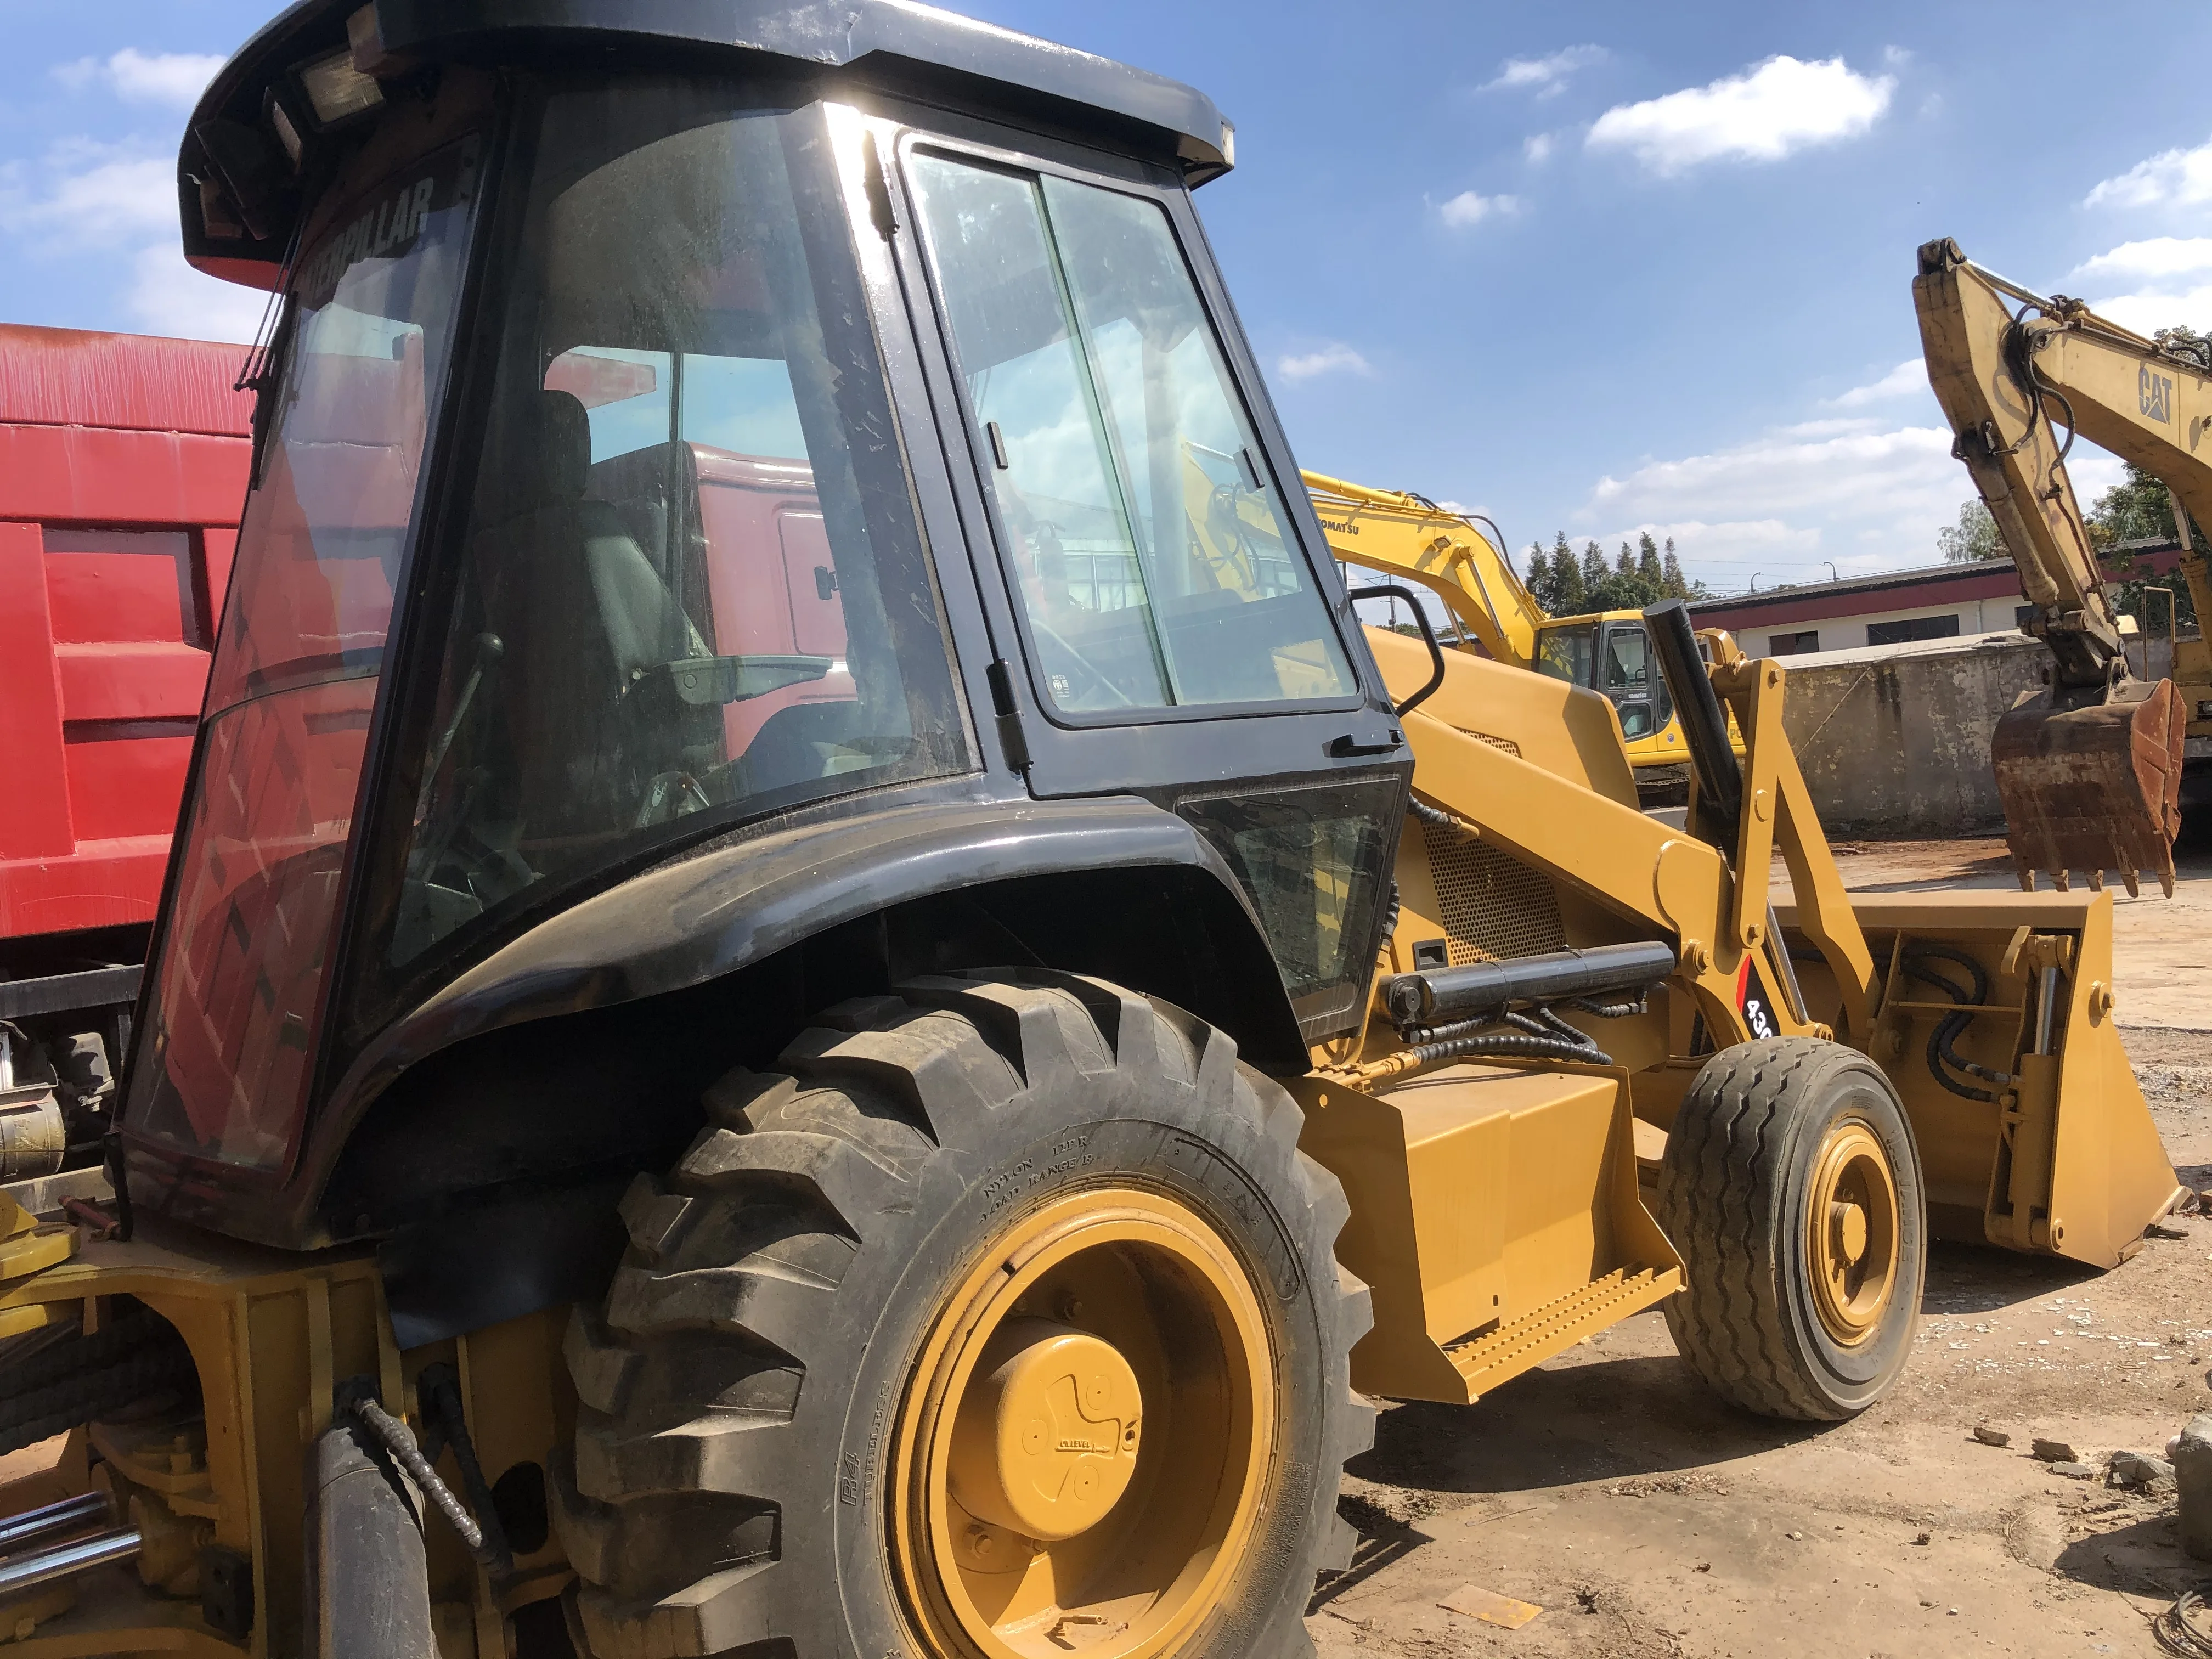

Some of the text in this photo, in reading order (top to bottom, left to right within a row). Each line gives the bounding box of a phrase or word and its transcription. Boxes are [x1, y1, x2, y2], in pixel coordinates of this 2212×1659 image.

[2138, 368, 2172, 426] CAT
[981, 1185, 1021, 1222] LOAD
[1028, 1157, 1077, 1190] RANGE
[983, 1156, 1034, 1199] NYLON
[862, 1380, 890, 1506] TUBELESS
[1070, 1439, 1090, 1448] LEVEL
[840, 1451, 861, 1507] R4
[1296, 1463, 1313, 1510] SAFETY
